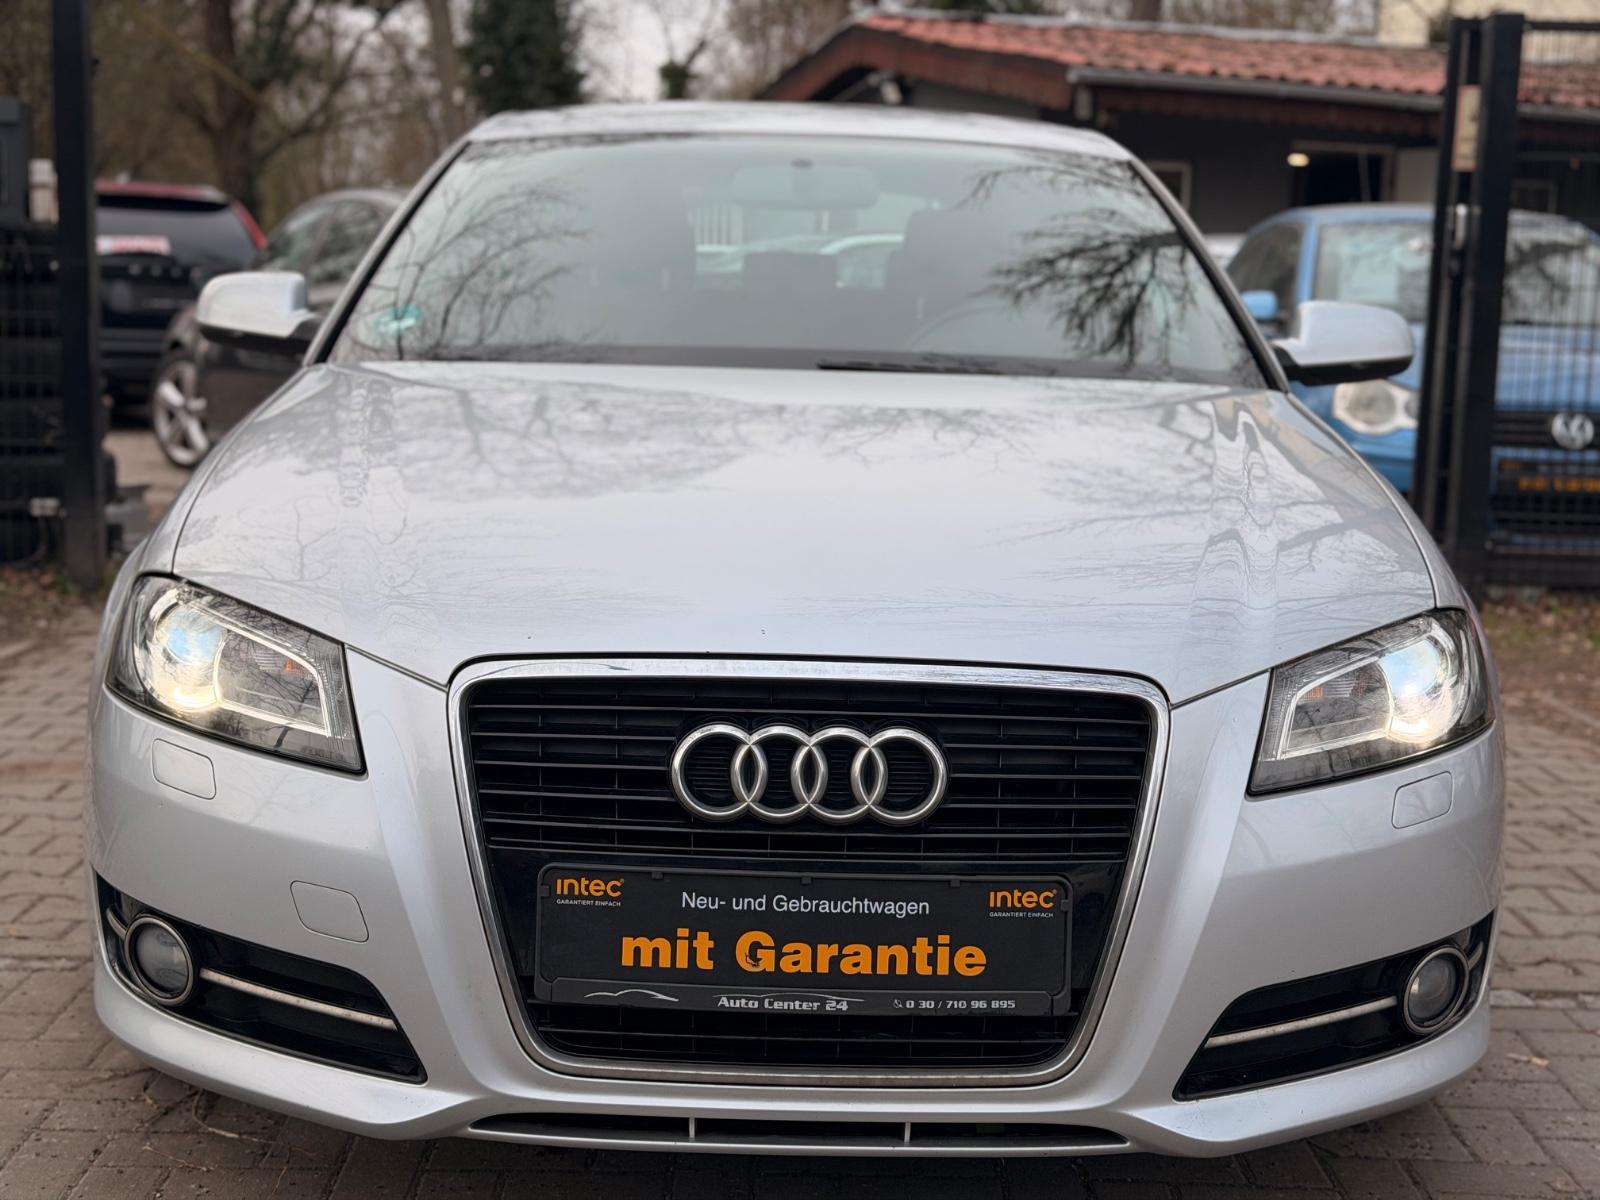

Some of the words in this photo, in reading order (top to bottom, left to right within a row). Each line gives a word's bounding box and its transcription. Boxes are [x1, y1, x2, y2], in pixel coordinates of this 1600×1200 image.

[681, 892, 726, 911] Neu-
[732, 895, 767, 911] und
[773, 895, 930, 918] Gebrauchtwagen
[621, 928, 714, 970] mit
[735, 931, 987, 977] Garantie
[717, 996, 759, 1008] Auto
[764, 998, 821, 1010] Center
[825, 1000, 849, 1011] 24
[918, 1000, 935, 1009] 30
[946, 1000, 967, 1009] 710
[970, 1000, 988, 1009] 96
[991, 1000, 1016, 1010] 895
